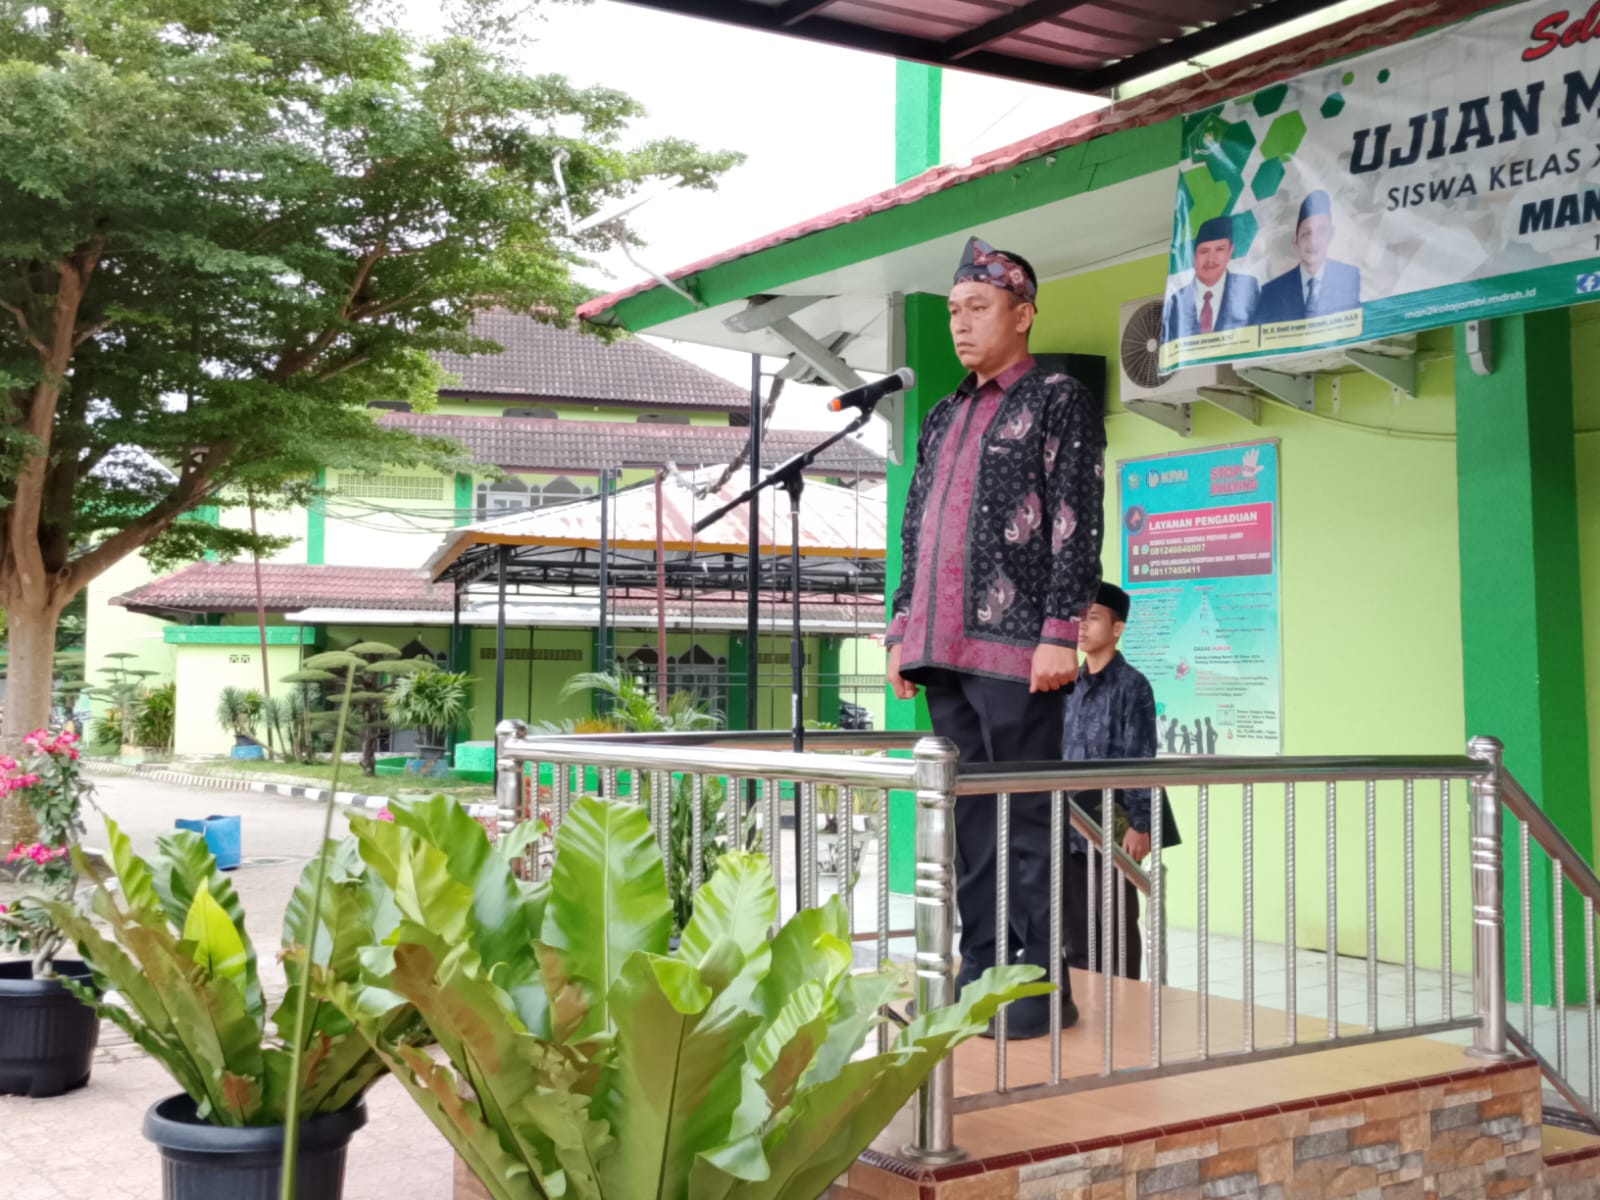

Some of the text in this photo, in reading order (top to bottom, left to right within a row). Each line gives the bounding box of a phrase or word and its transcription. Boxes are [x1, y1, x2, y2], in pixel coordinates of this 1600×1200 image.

[1350, 81, 1545, 174] UJIAN
[1387, 173, 1477, 211] SISWA
[1489, 148, 1581, 190] KELAS
[1149, 512, 1257, 531] LAYANAN PENGADUAN
